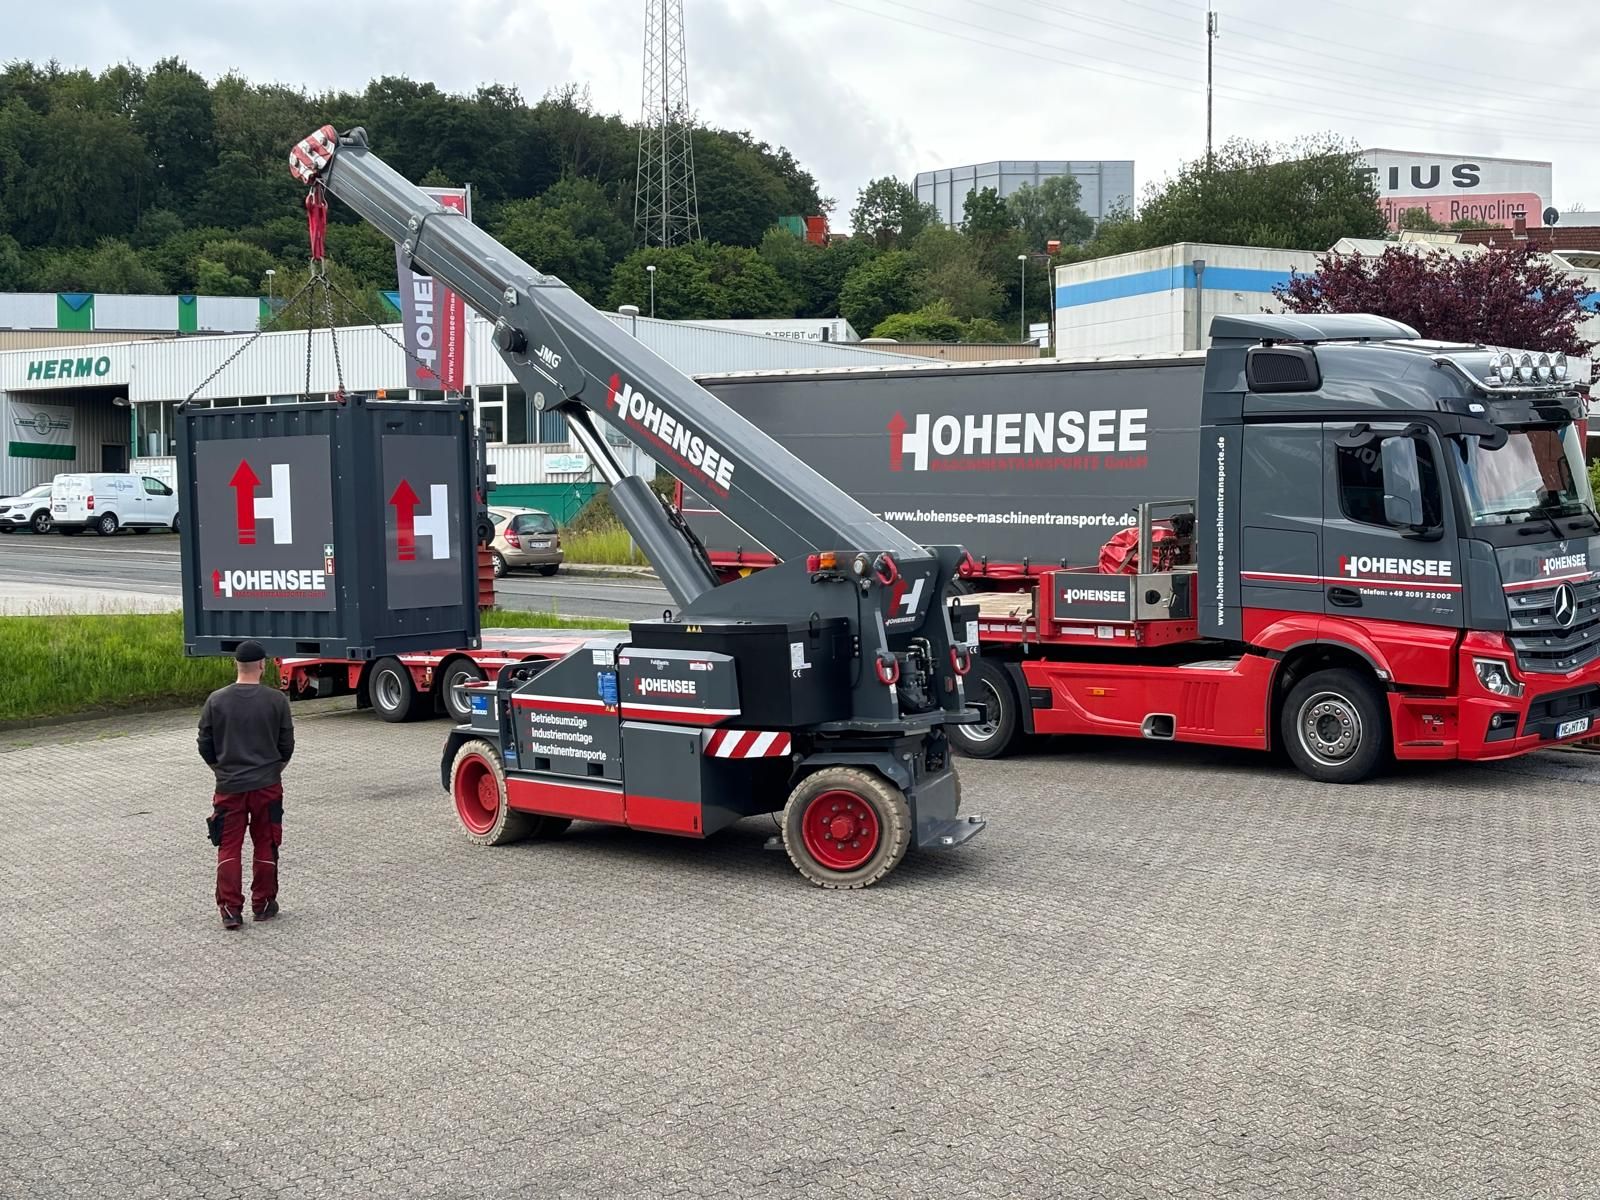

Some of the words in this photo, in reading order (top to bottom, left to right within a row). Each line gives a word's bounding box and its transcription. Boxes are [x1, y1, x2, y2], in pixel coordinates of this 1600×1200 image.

[534, 345, 562, 369] JMG
[27, 356, 111, 381] HERMO
[607, 373, 735, 490] HOHENSEE
[887, 409, 1148, 471] HOHENSEE
[884, 509, 1137, 529] www.hohensee-maschinentransporte.de
[1339, 555, 1452, 577] HOHENSEE
[1540, 553, 1587, 576] HOHENSEE
[211, 569, 326, 598] HOHENSEE
[1360, 588, 1388, 597] Telefon:
[1389, 590, 1403, 598] +49
[1405, 591, 1424, 599] 2051
[1060, 587, 1126, 604] HOHENSEE
[635, 675, 697, 696] HOHENSEE
[531, 712, 588, 730] Betriebsumzüge
[531, 727, 593, 745] Industriemontage
[532, 742, 607, 761] Maschinentransporte
